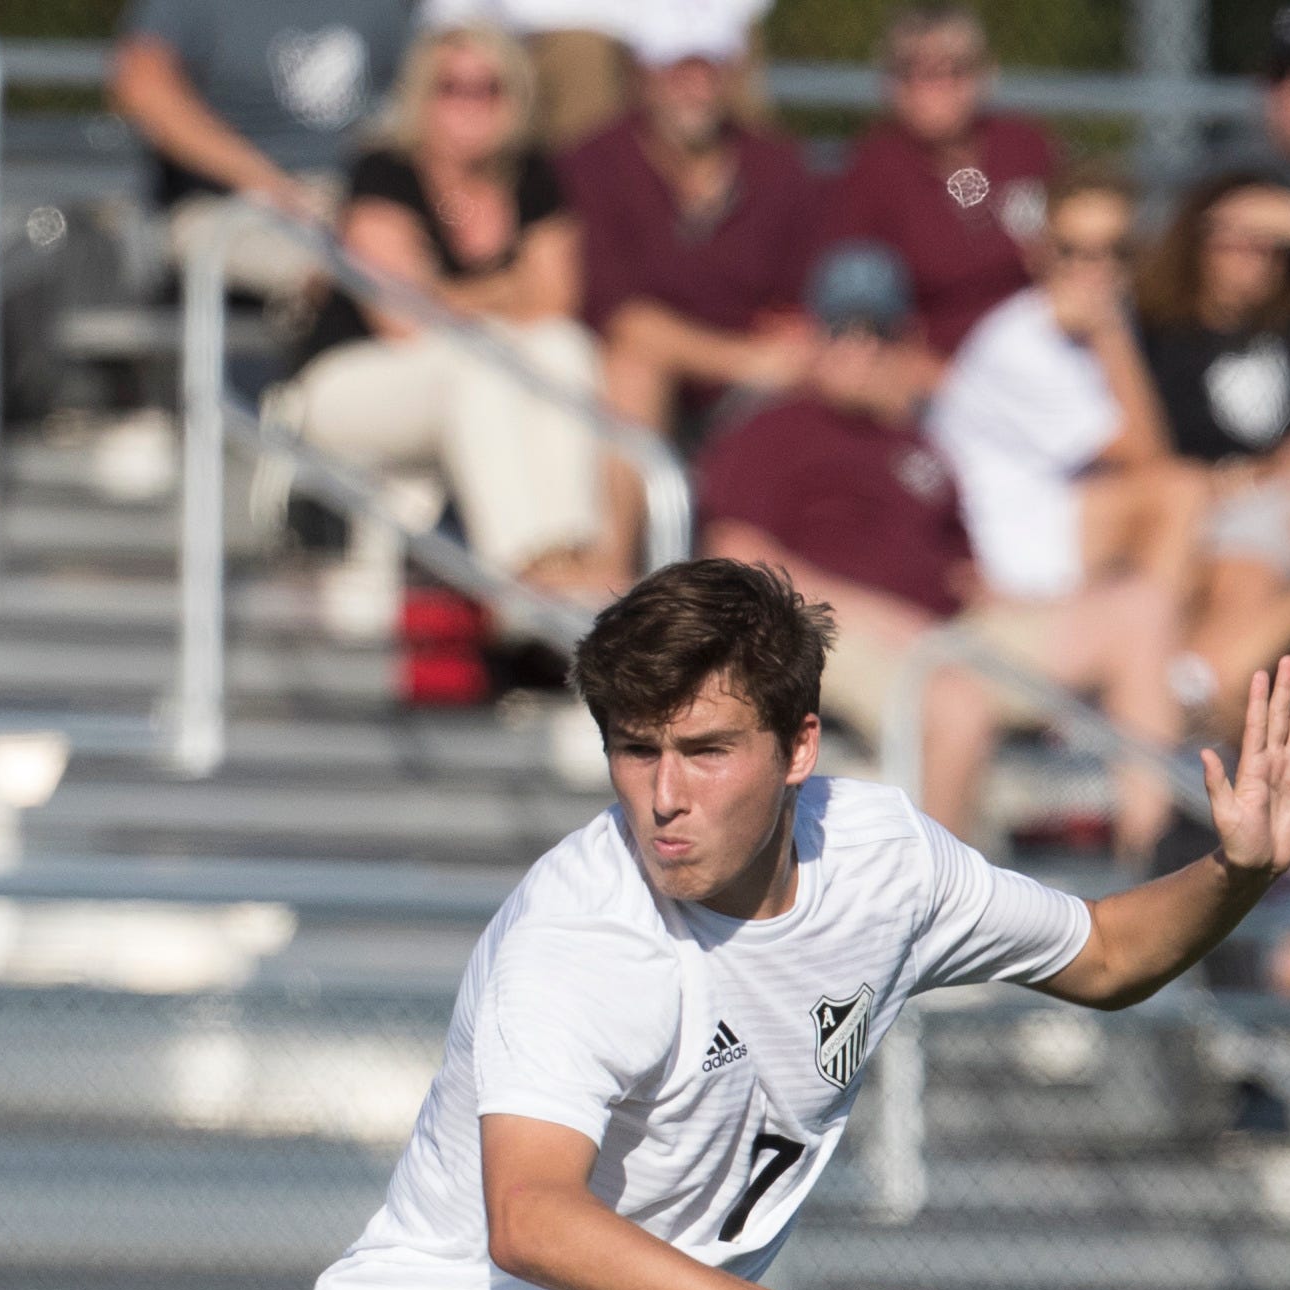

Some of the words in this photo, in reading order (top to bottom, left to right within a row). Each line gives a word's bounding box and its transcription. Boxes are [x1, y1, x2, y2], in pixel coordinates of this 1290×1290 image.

[822, 1006, 836, 1029] A
[702, 1043, 748, 1073] adidas
[718, 1133, 806, 1241] 7
